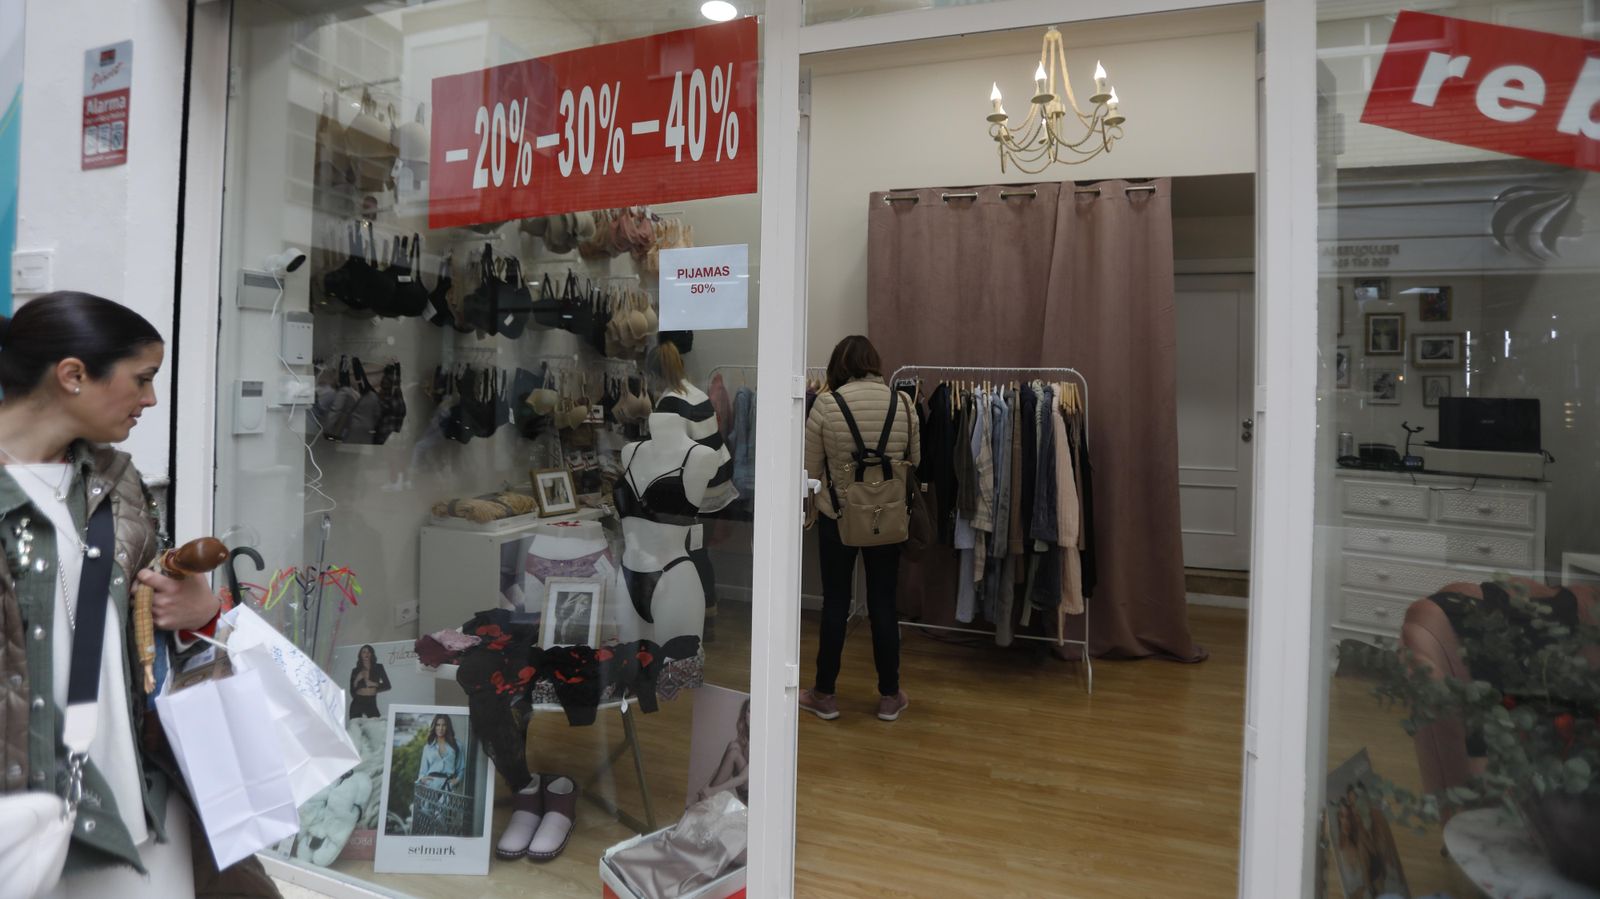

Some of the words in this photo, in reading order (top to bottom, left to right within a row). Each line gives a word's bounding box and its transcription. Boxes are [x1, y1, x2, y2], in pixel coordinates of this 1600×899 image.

[87, 95, 126, 115] Alarma
[677, 266, 730, 279] PIJAMAS
[690, 283, 716, 294] 50%
[408, 845, 456, 856] selmark
